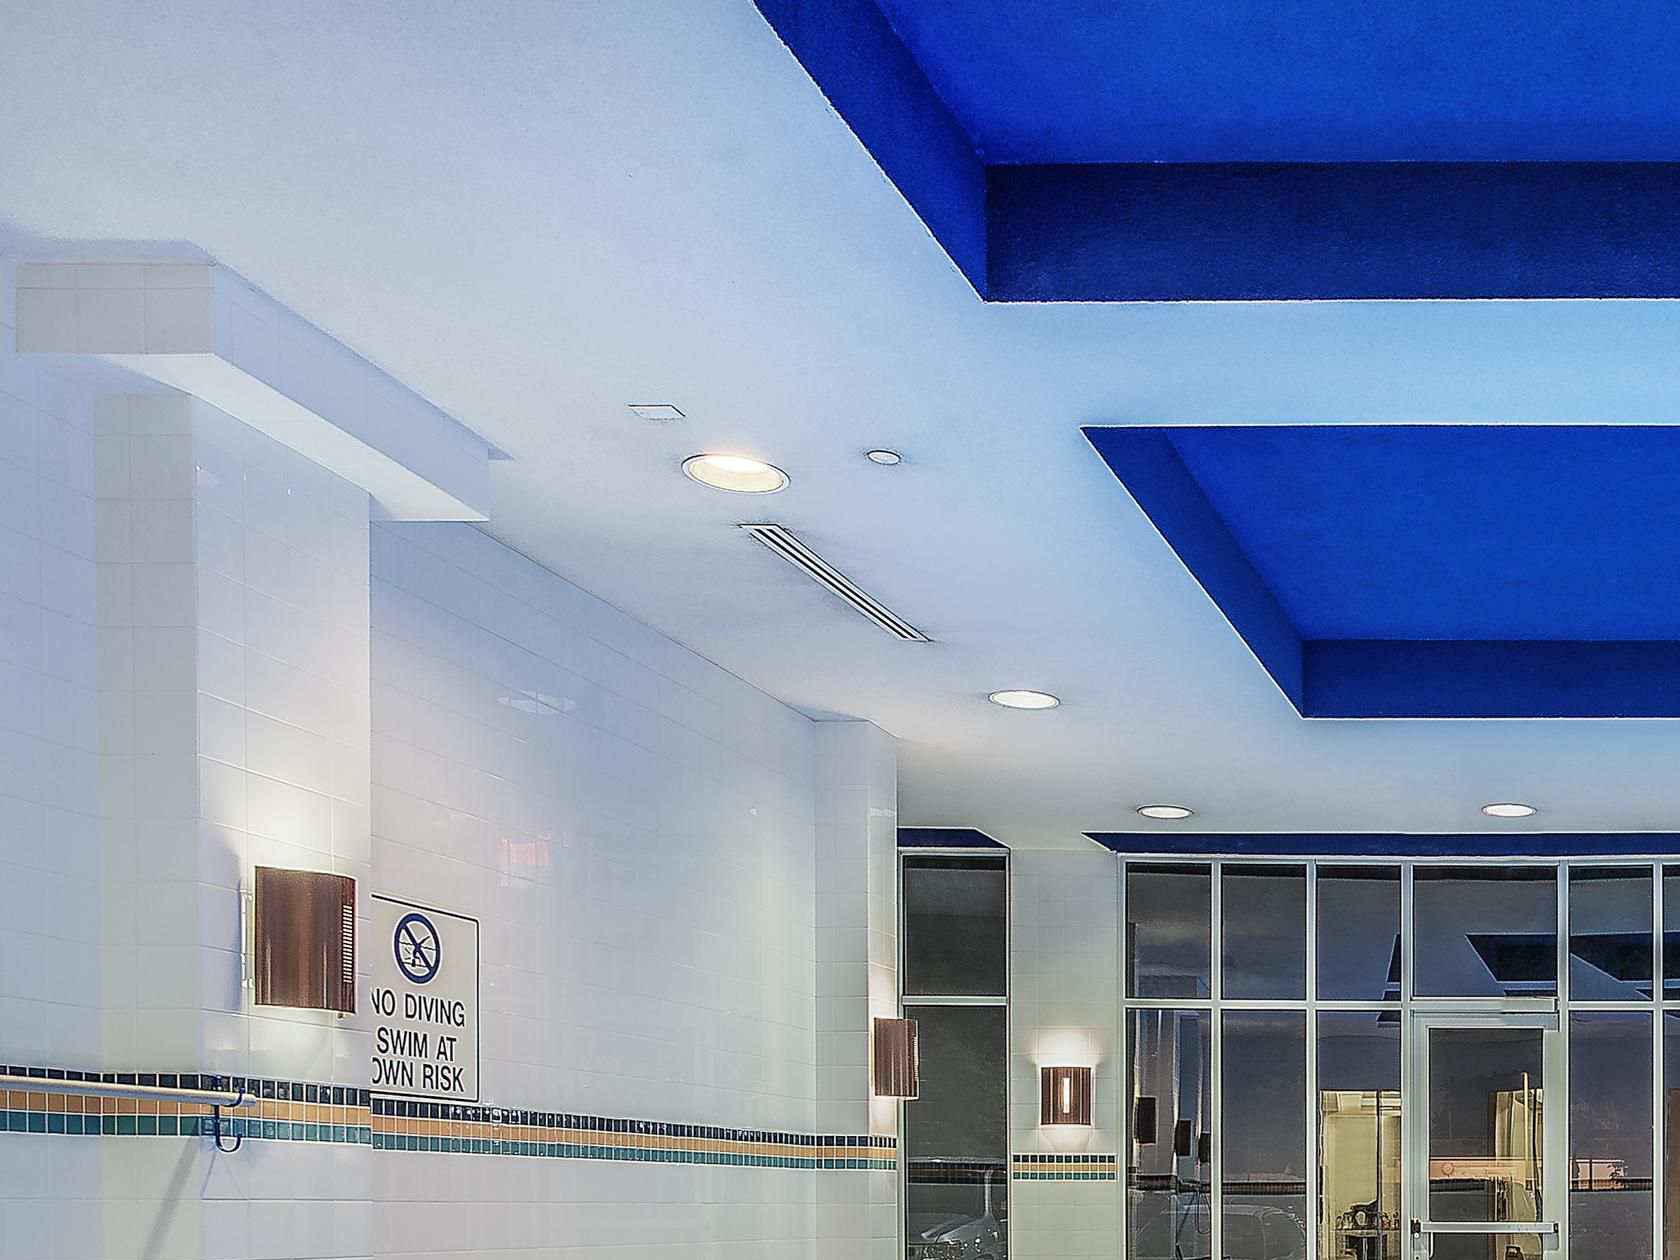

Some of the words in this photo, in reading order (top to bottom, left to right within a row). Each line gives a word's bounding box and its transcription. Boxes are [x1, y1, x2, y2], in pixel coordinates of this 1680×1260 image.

[371, 988, 396, 1017] NO
[405, 993, 465, 1027] DIVING
[376, 1026, 428, 1058] SWIM
[436, 1036, 457, 1062] AT
[372, 1057, 413, 1087] OWN
[422, 1063, 465, 1092] RISK
